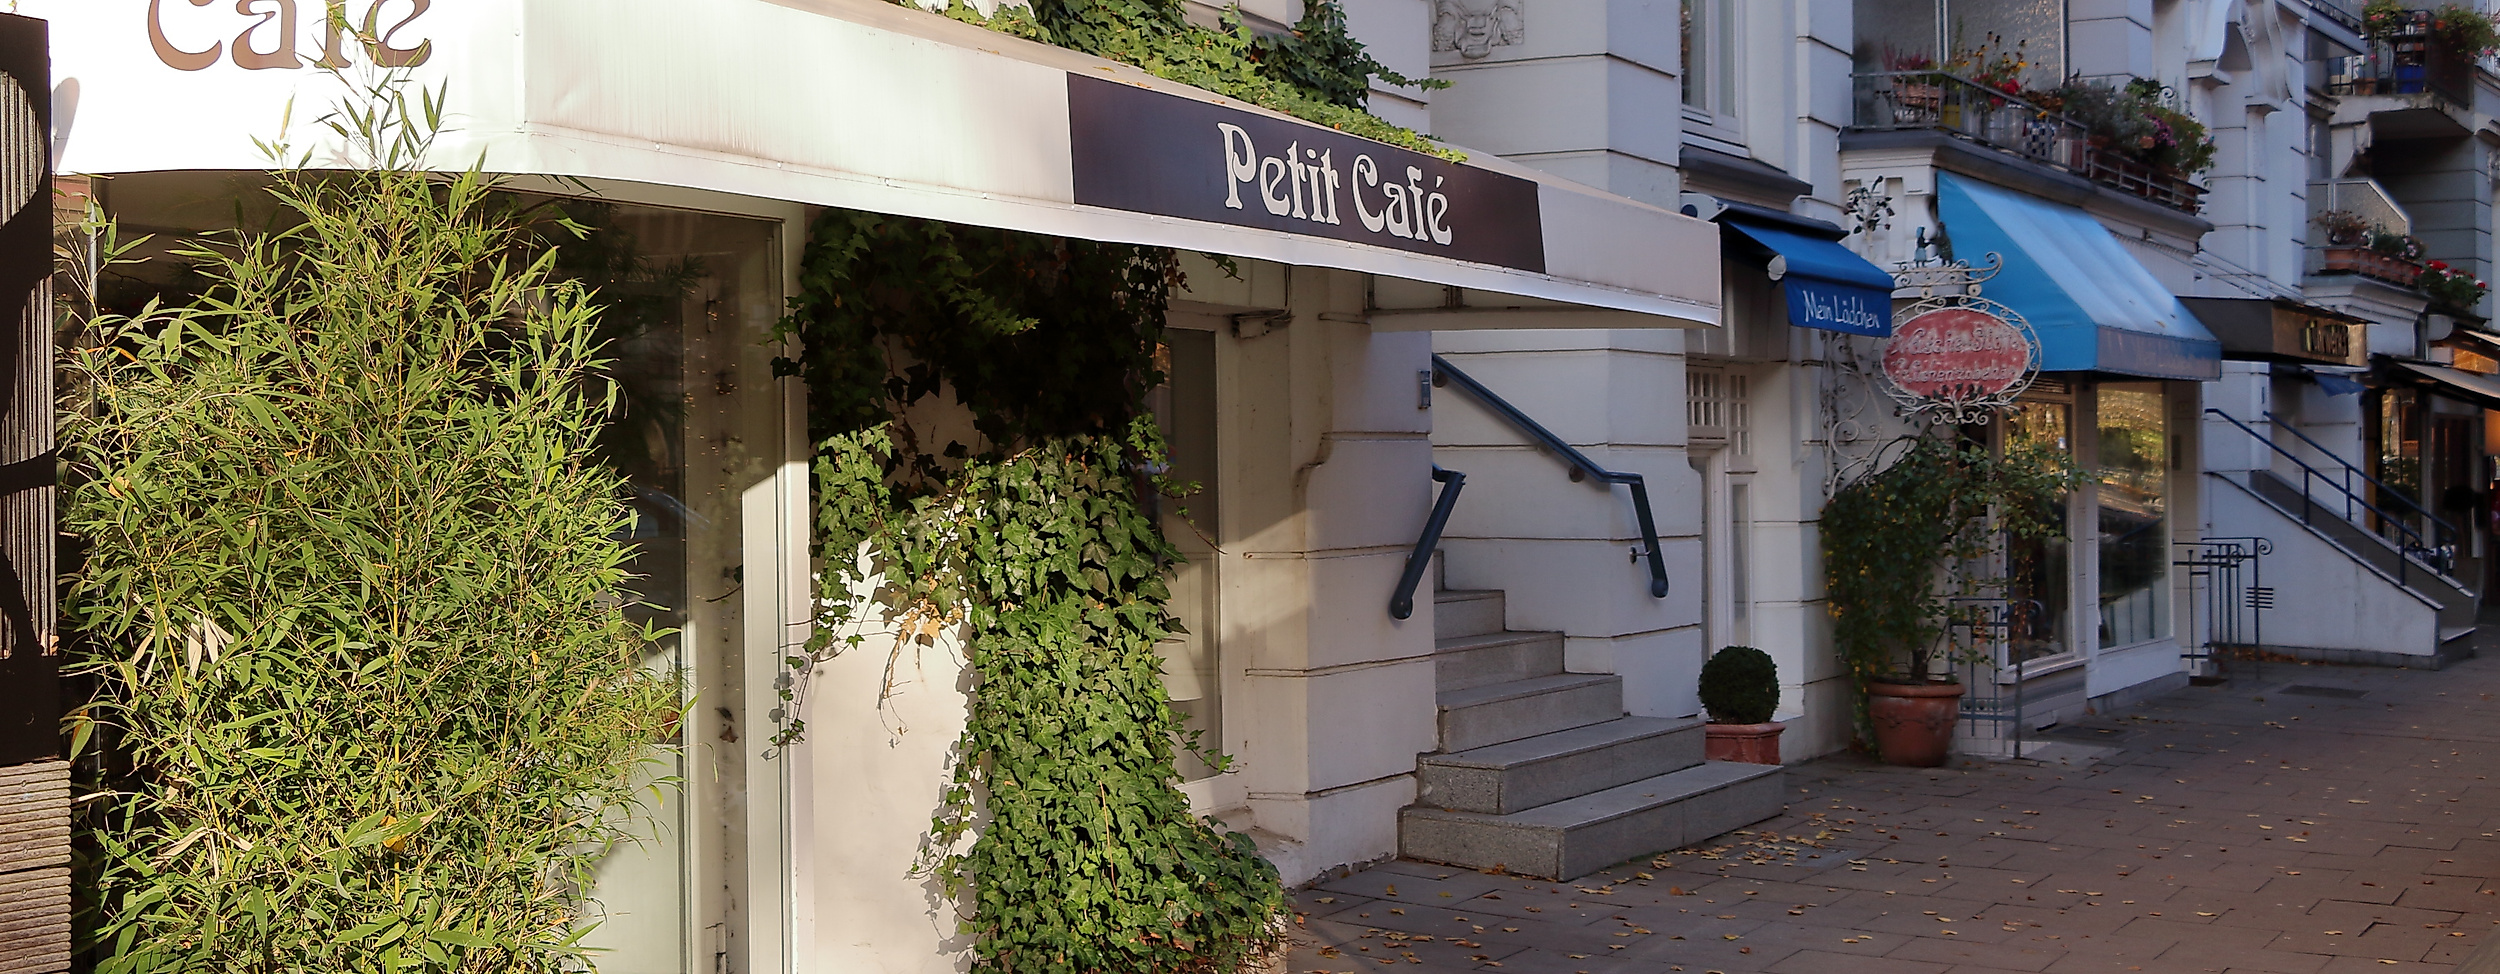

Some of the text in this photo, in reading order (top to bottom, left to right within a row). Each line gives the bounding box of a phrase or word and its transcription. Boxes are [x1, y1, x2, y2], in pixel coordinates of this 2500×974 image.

[1217, 121, 1453, 246] Petit Café
[1803, 290, 1880, 329] Mein Lädchen
